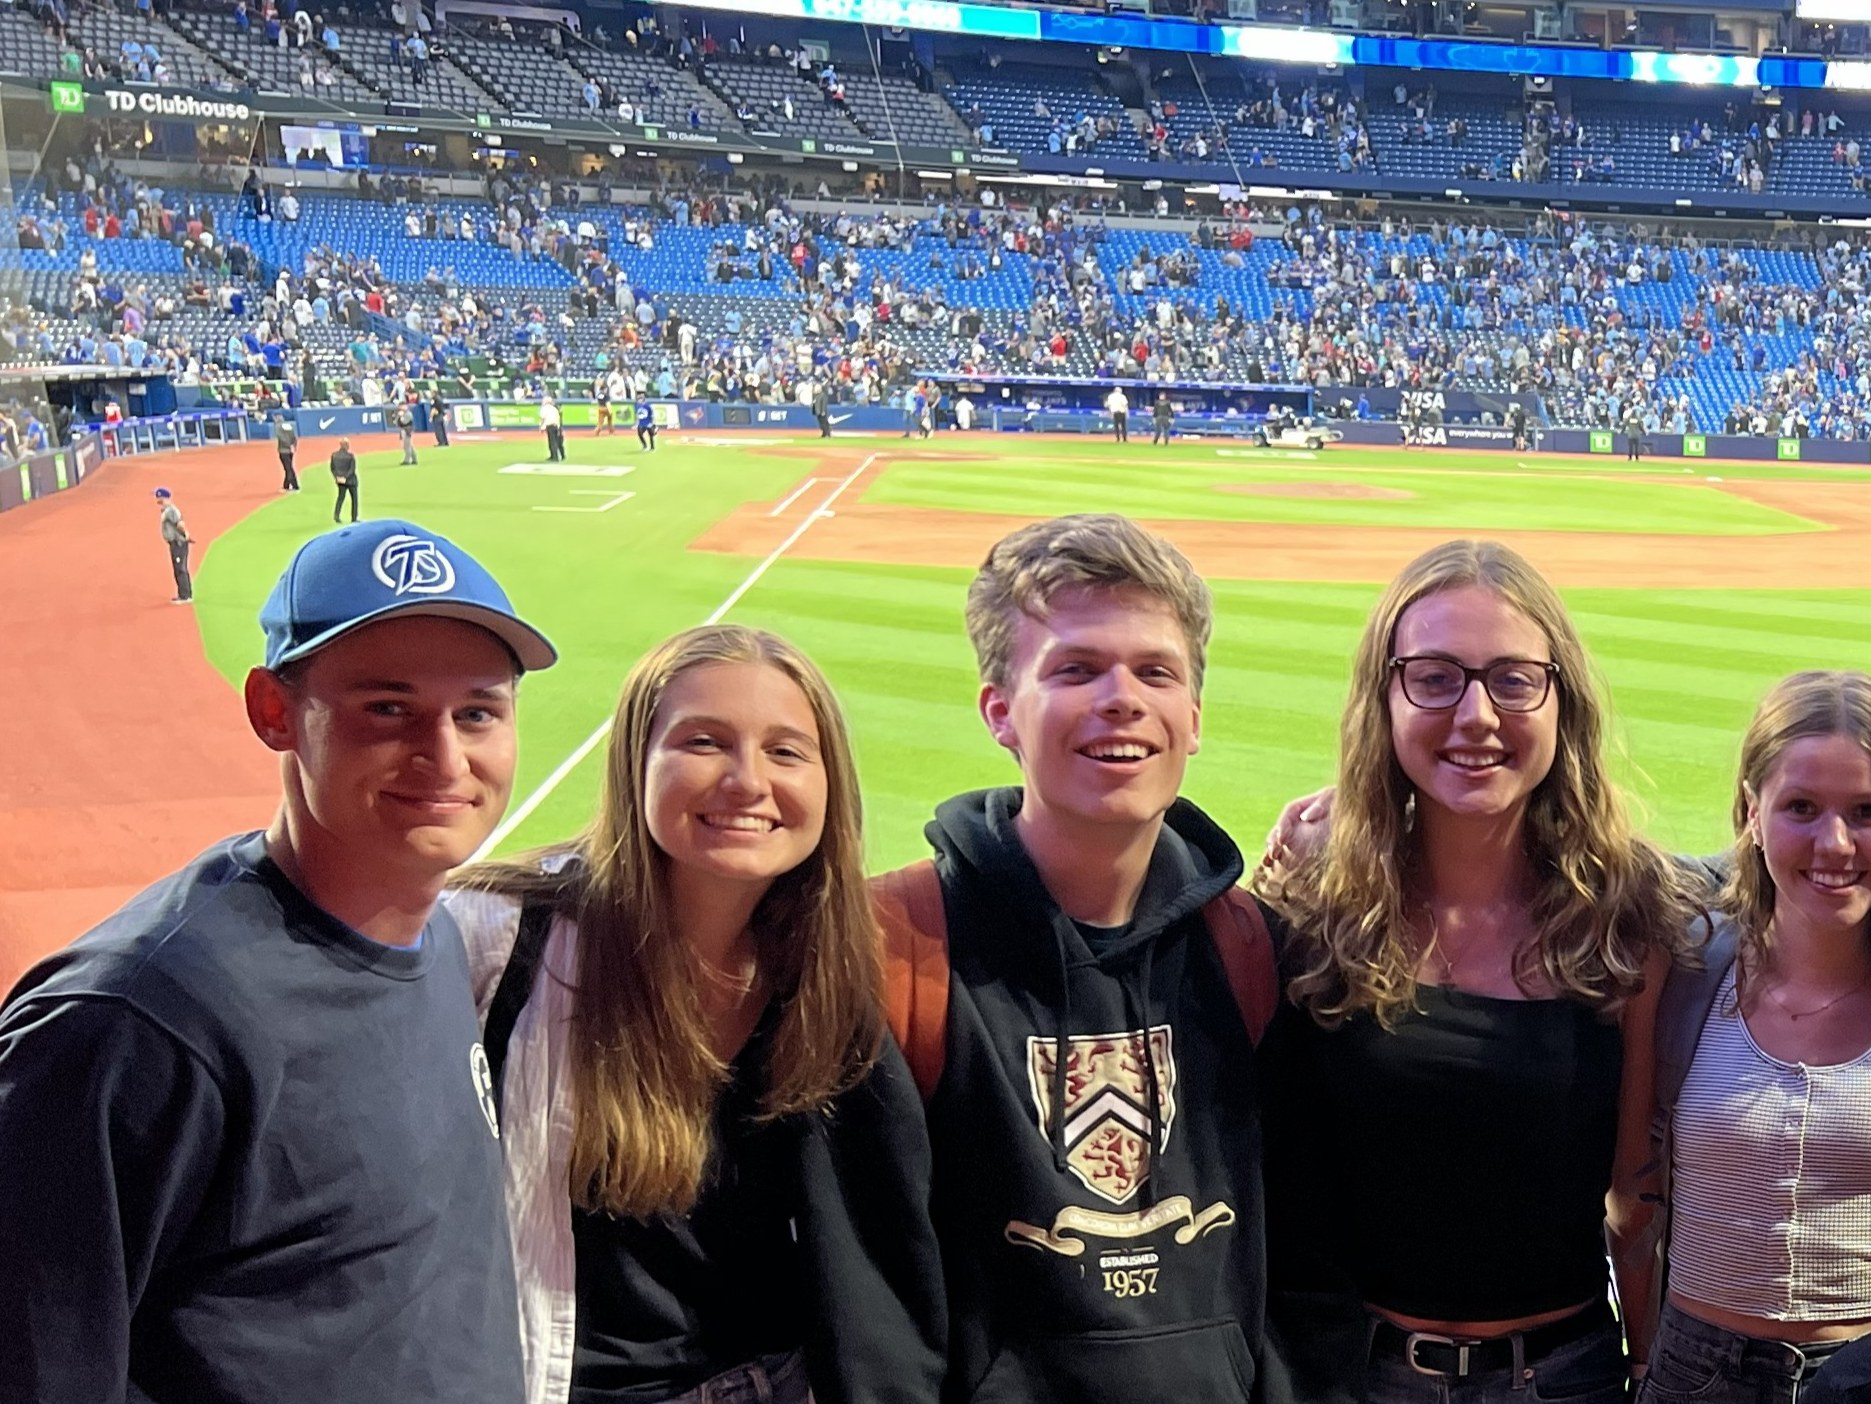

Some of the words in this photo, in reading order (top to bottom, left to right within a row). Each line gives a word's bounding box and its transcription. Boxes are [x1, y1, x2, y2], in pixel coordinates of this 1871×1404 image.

[55, 87, 81, 107] TD
[105, 90, 136, 111] TD
[139, 92, 249, 119] Clubhouse
[512, 119, 551, 130] Clubhouse
[679, 132, 717, 143] Clubhouse
[836, 144, 874, 155] Clubhouse
[1594, 436, 1610, 448] TD
[1686, 439, 1704, 452] TD
[1781, 443, 1798, 455] TD
[1099, 1253, 1159, 1268] ESTABLISHED
[1102, 1268, 1159, 1298] 1957
